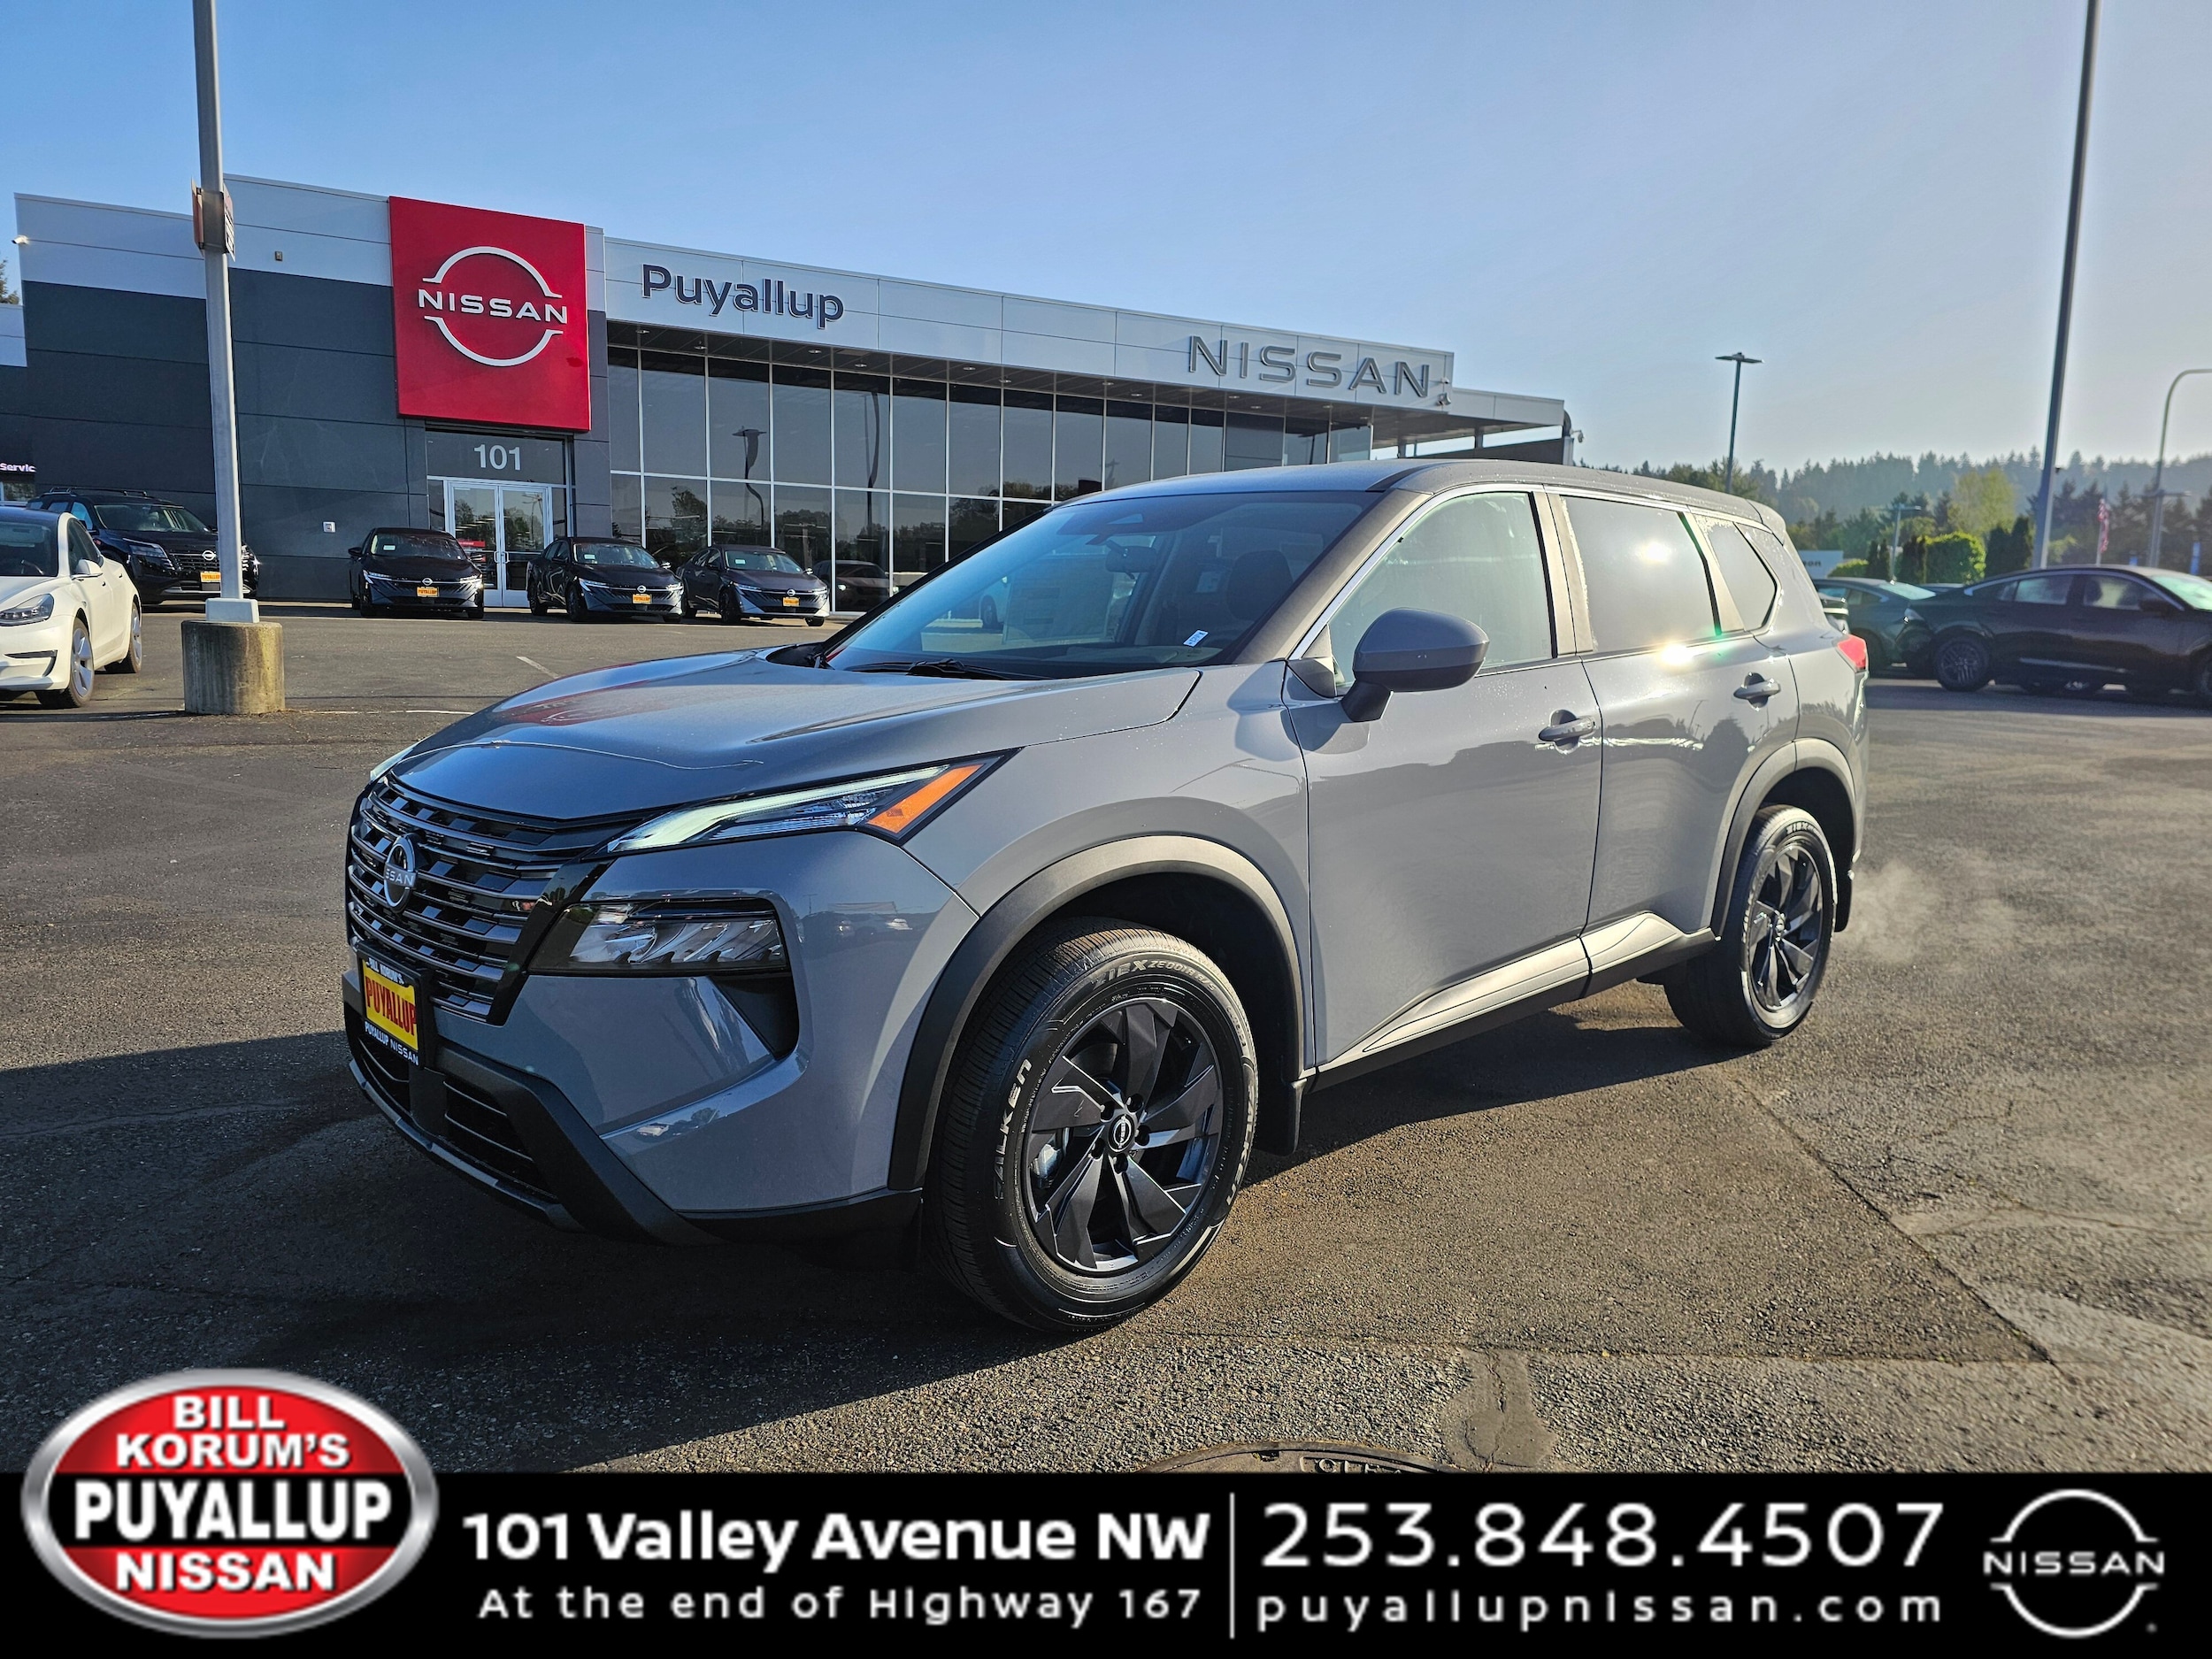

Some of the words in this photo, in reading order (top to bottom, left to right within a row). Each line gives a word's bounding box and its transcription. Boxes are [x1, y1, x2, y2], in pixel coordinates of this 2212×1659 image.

[418, 288, 567, 324] NISSAN
[641, 264, 845, 329] Puyallup
[1189, 335, 1431, 398] NISSAN
[473, 444, 521, 471] 101
[365, 975, 417, 1037] PUYALLUP
[364, 1020, 389, 1046] PUYALLUP
[389, 1038, 419, 1066] NISSAN
